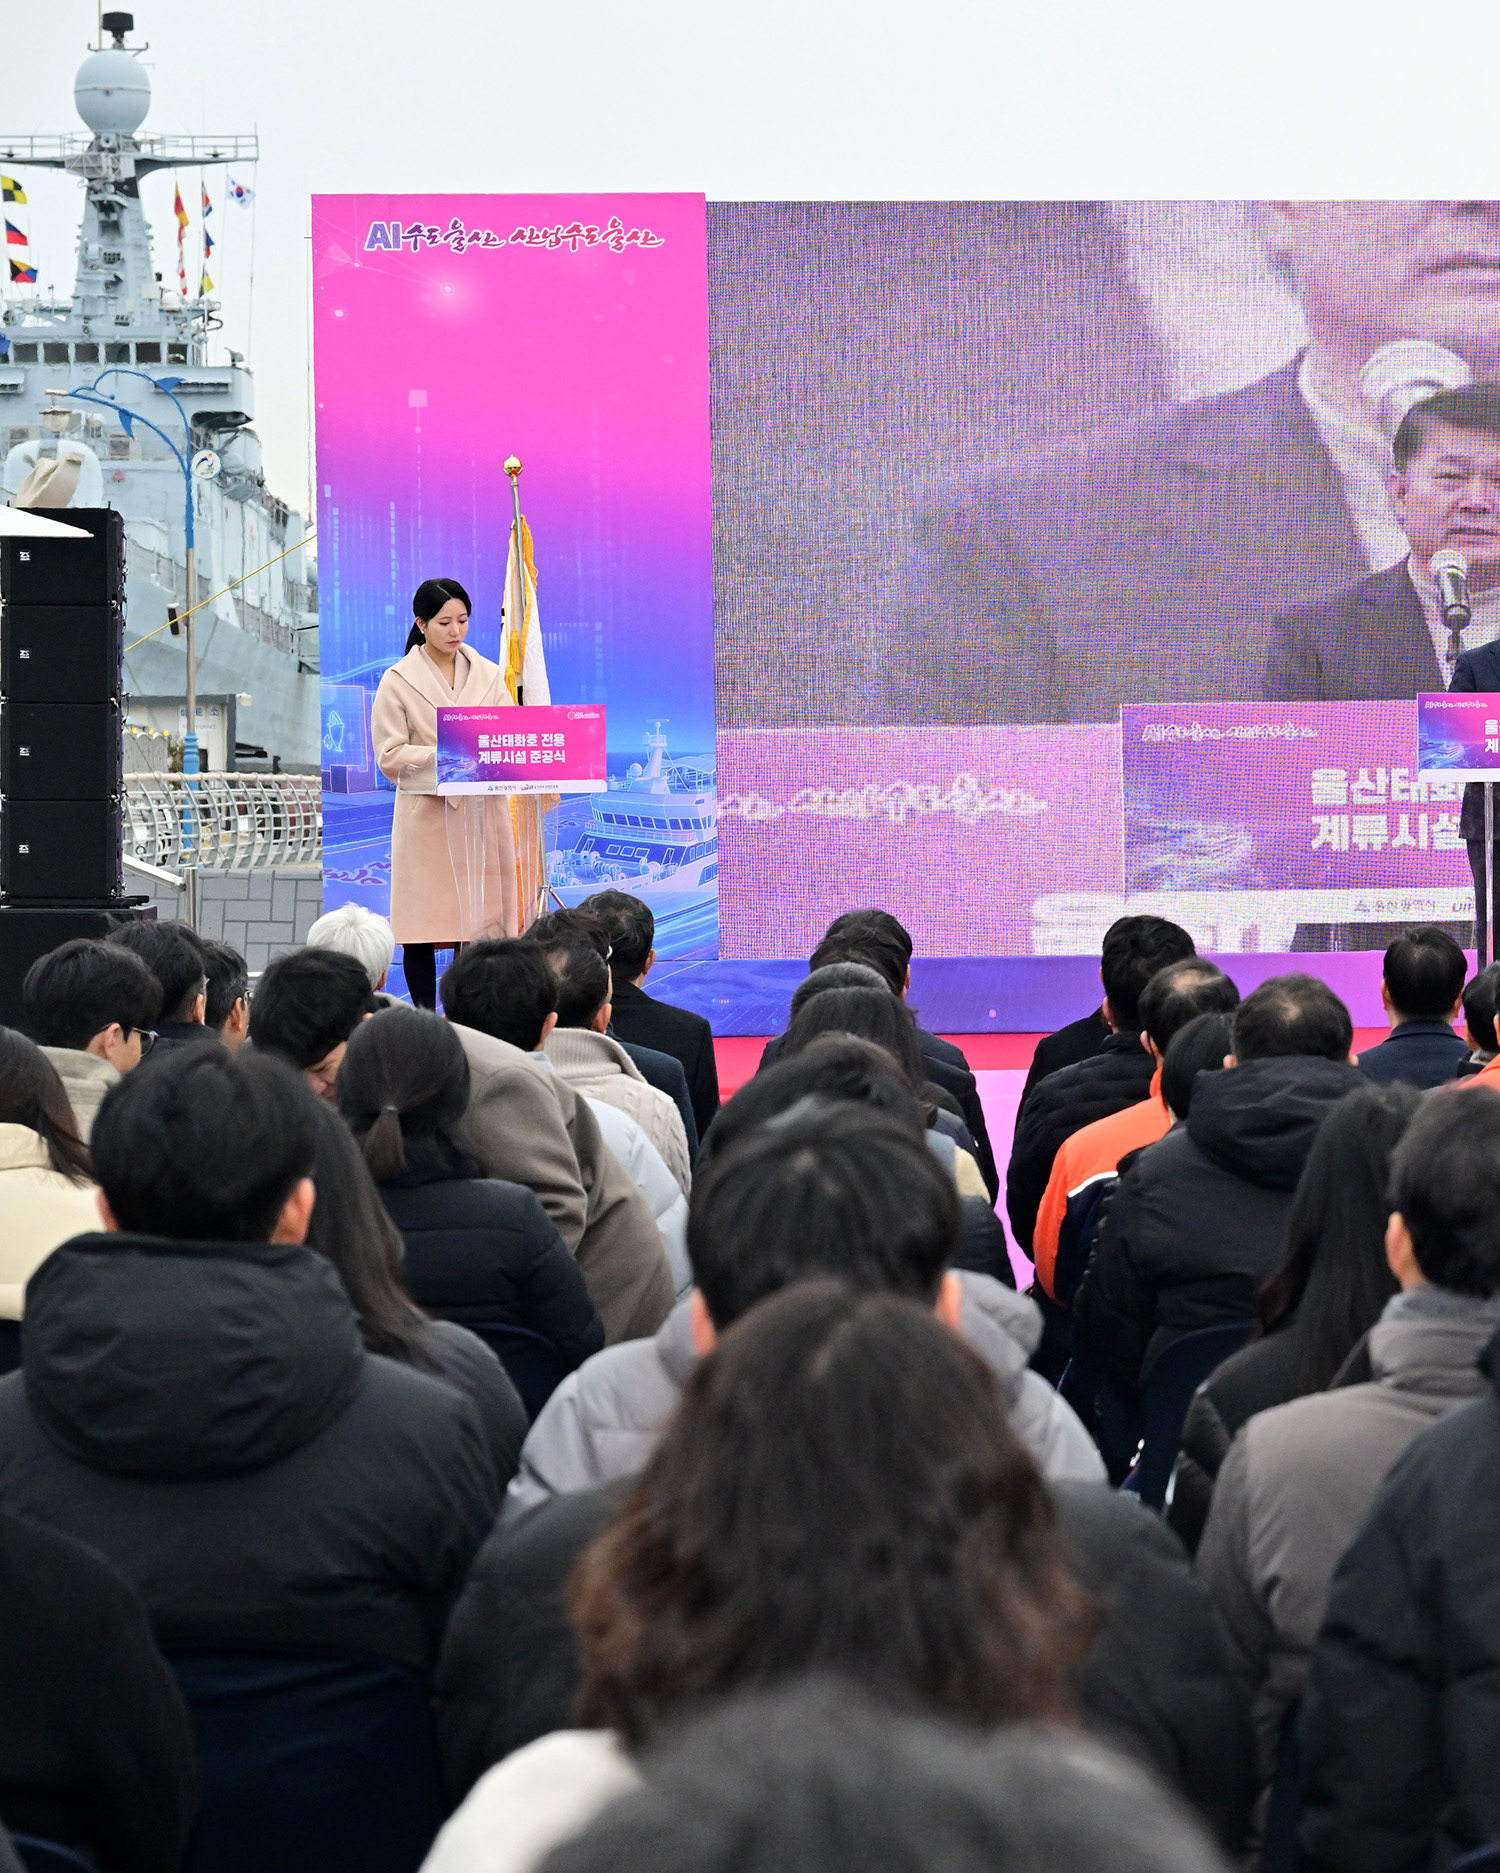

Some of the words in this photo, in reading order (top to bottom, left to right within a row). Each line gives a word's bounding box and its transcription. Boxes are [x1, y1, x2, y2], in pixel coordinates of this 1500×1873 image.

[510, 217, 662, 252] 산업수도울산
[478, 734, 538, 748] 울산태화호
[541, 733, 565, 747] 전용
[478, 751, 526, 764] 계류시설
[530, 749, 565, 764] 준공식
